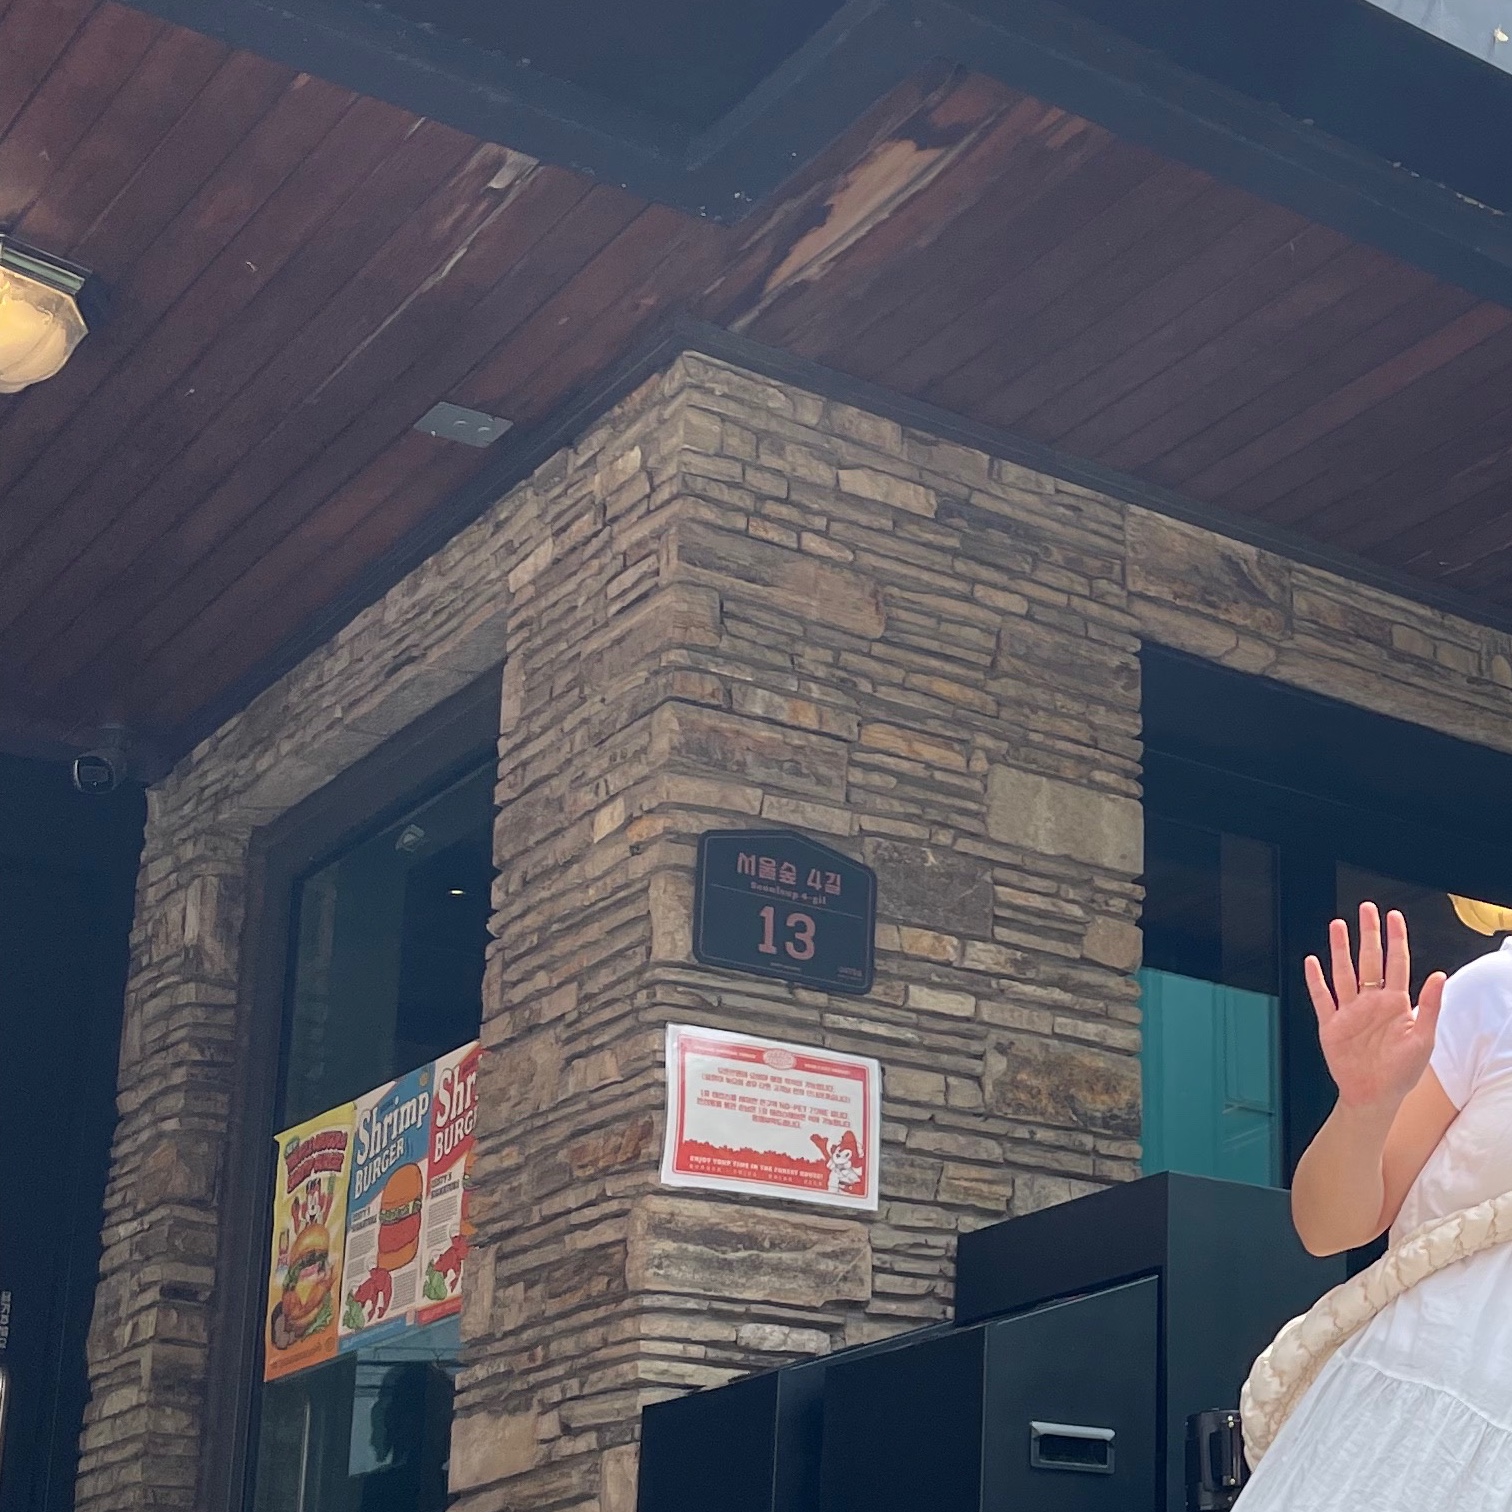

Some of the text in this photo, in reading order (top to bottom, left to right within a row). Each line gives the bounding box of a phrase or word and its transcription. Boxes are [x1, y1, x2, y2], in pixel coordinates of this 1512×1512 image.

[806, 868, 841, 896] 4길
[758, 905, 816, 961] 13
[436, 1064, 479, 1128] Shr
[357, 1091, 431, 1166] Shrimp
[433, 1106, 478, 1164] BURG
[355, 1137, 405, 1200] BURGER
